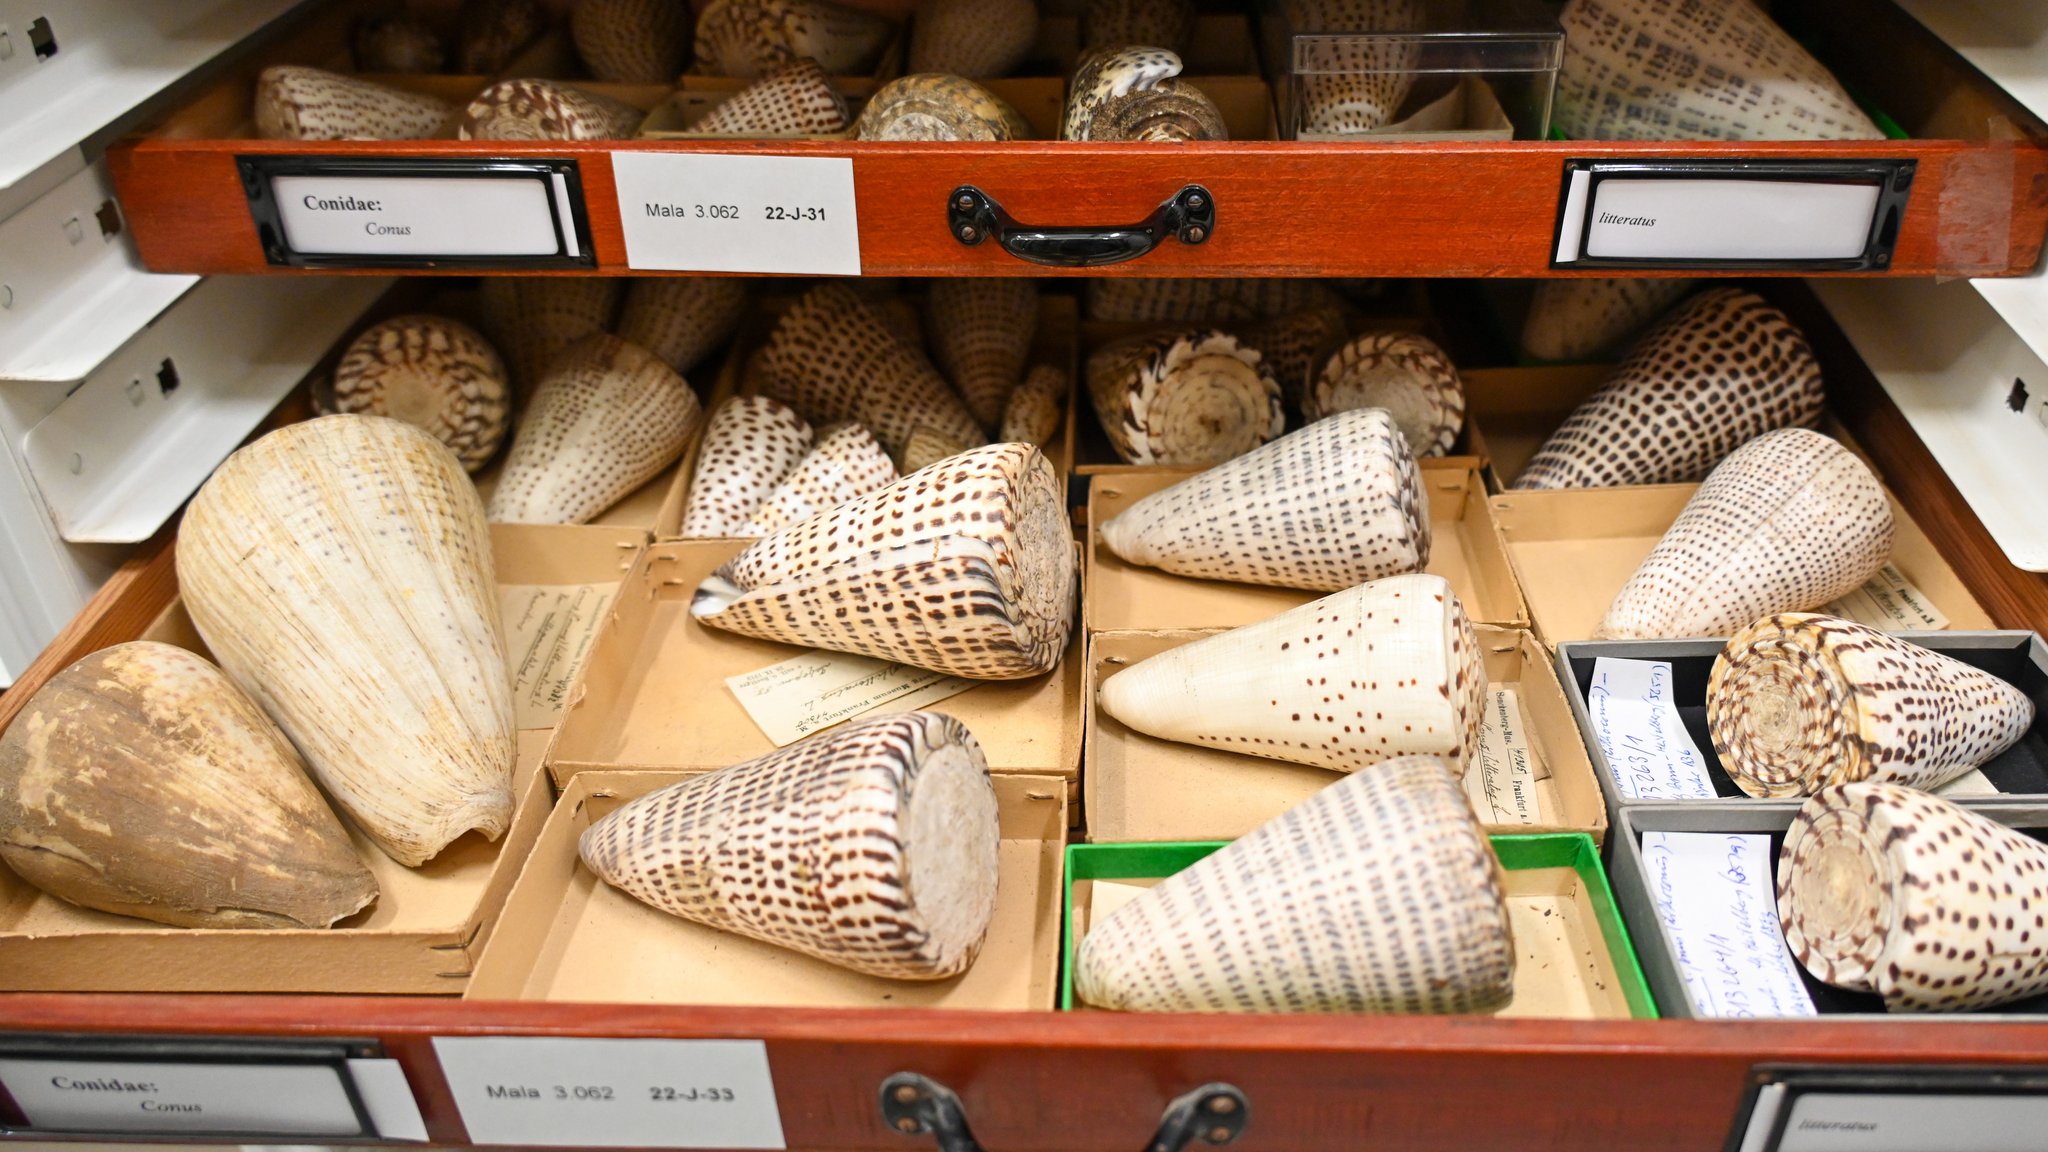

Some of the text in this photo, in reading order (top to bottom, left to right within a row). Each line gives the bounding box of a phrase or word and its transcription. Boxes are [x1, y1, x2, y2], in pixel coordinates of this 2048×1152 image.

[303, 195, 383, 211] Conidae:
[645, 203, 826, 221] Mala 3.062 22-J-31
[1599, 211, 1657, 227] litteratus
[365, 222, 411, 236] Conus
[823, 699, 871, 721] Frankfurt
[1513, 780, 1527, 811] Frankfurt
[51, 1076, 159, 1093] Conidae:
[486, 1085, 736, 1100] Mala 3.062 22-J-33
[140, 1100, 202, 1113] Conus
